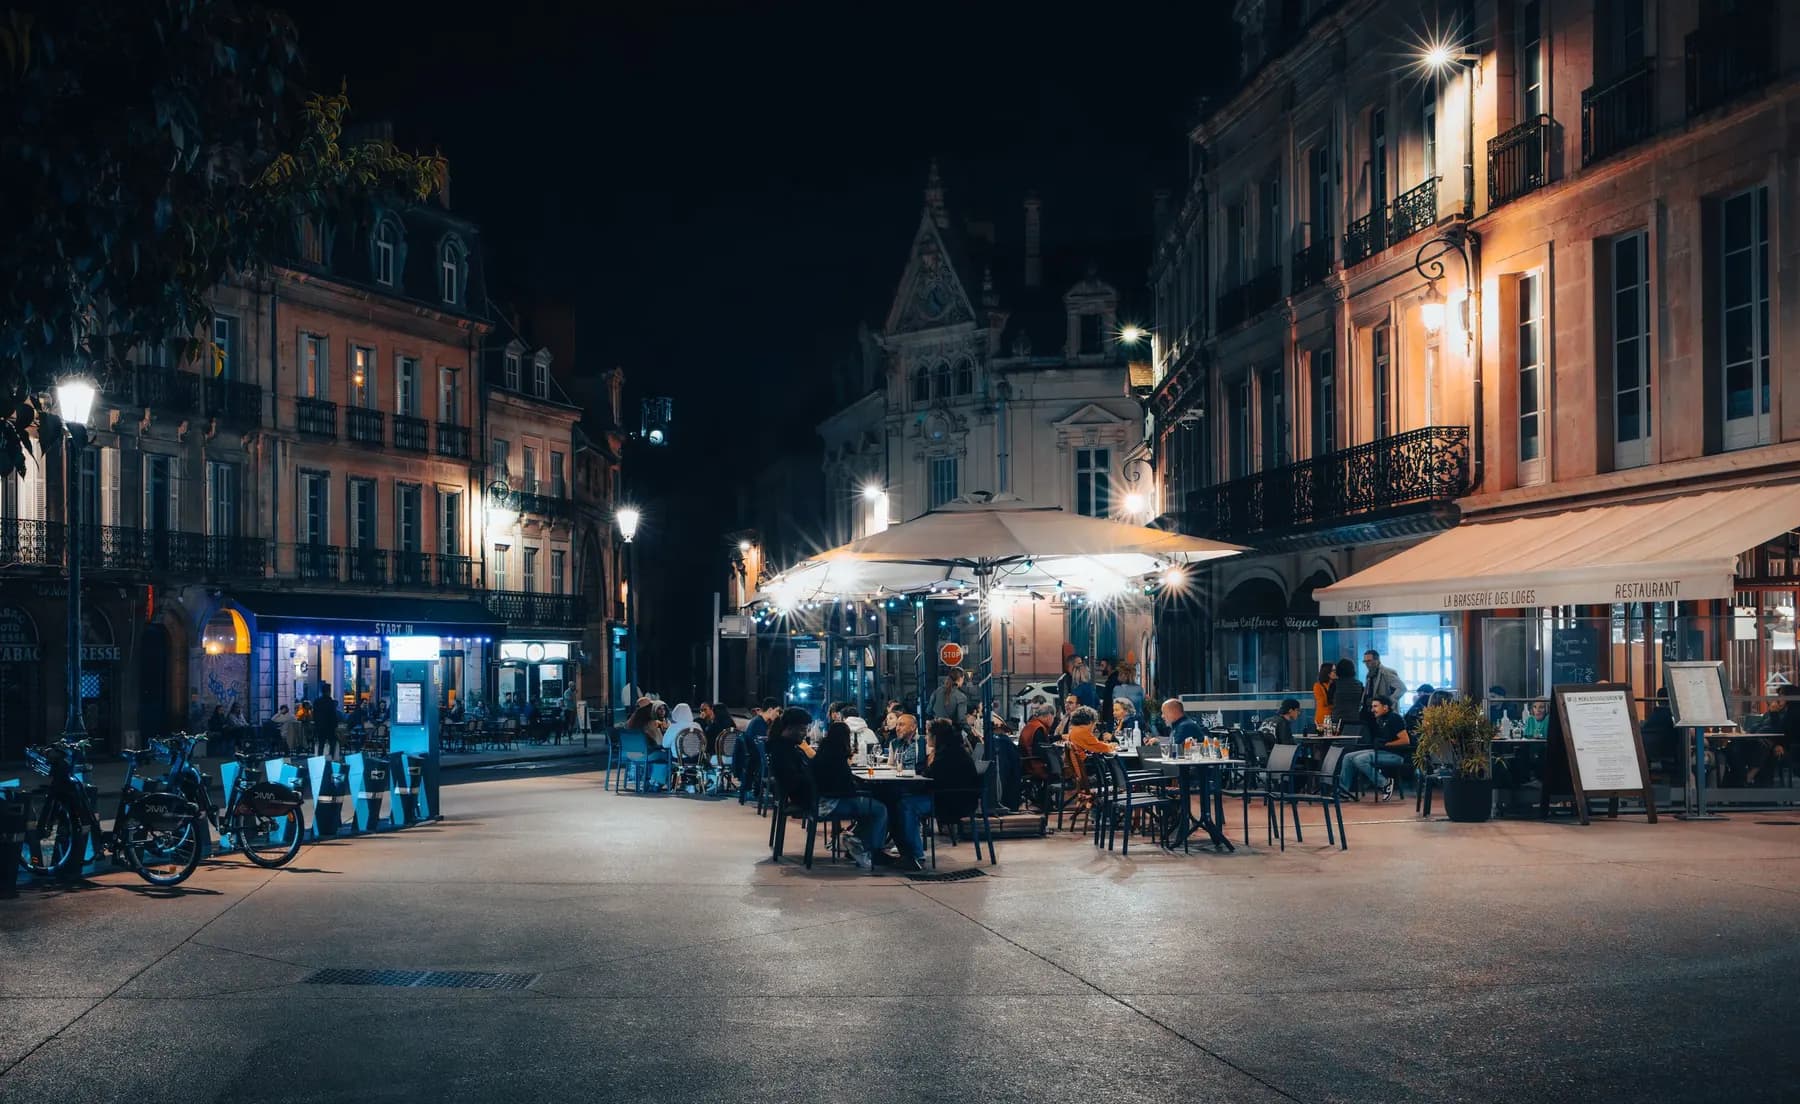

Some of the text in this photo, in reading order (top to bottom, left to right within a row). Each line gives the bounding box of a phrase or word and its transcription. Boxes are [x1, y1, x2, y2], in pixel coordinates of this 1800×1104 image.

[1615, 580, 1681, 599] RESTAURANT
[1443, 589, 1536, 608] LA BRASSERIE DES LOGES
[1347, 599, 1371, 612] GLACIER
[375, 622, 402, 635] START
[79, 647, 121, 661] RESSE
[943, 651, 961, 659] STOP
